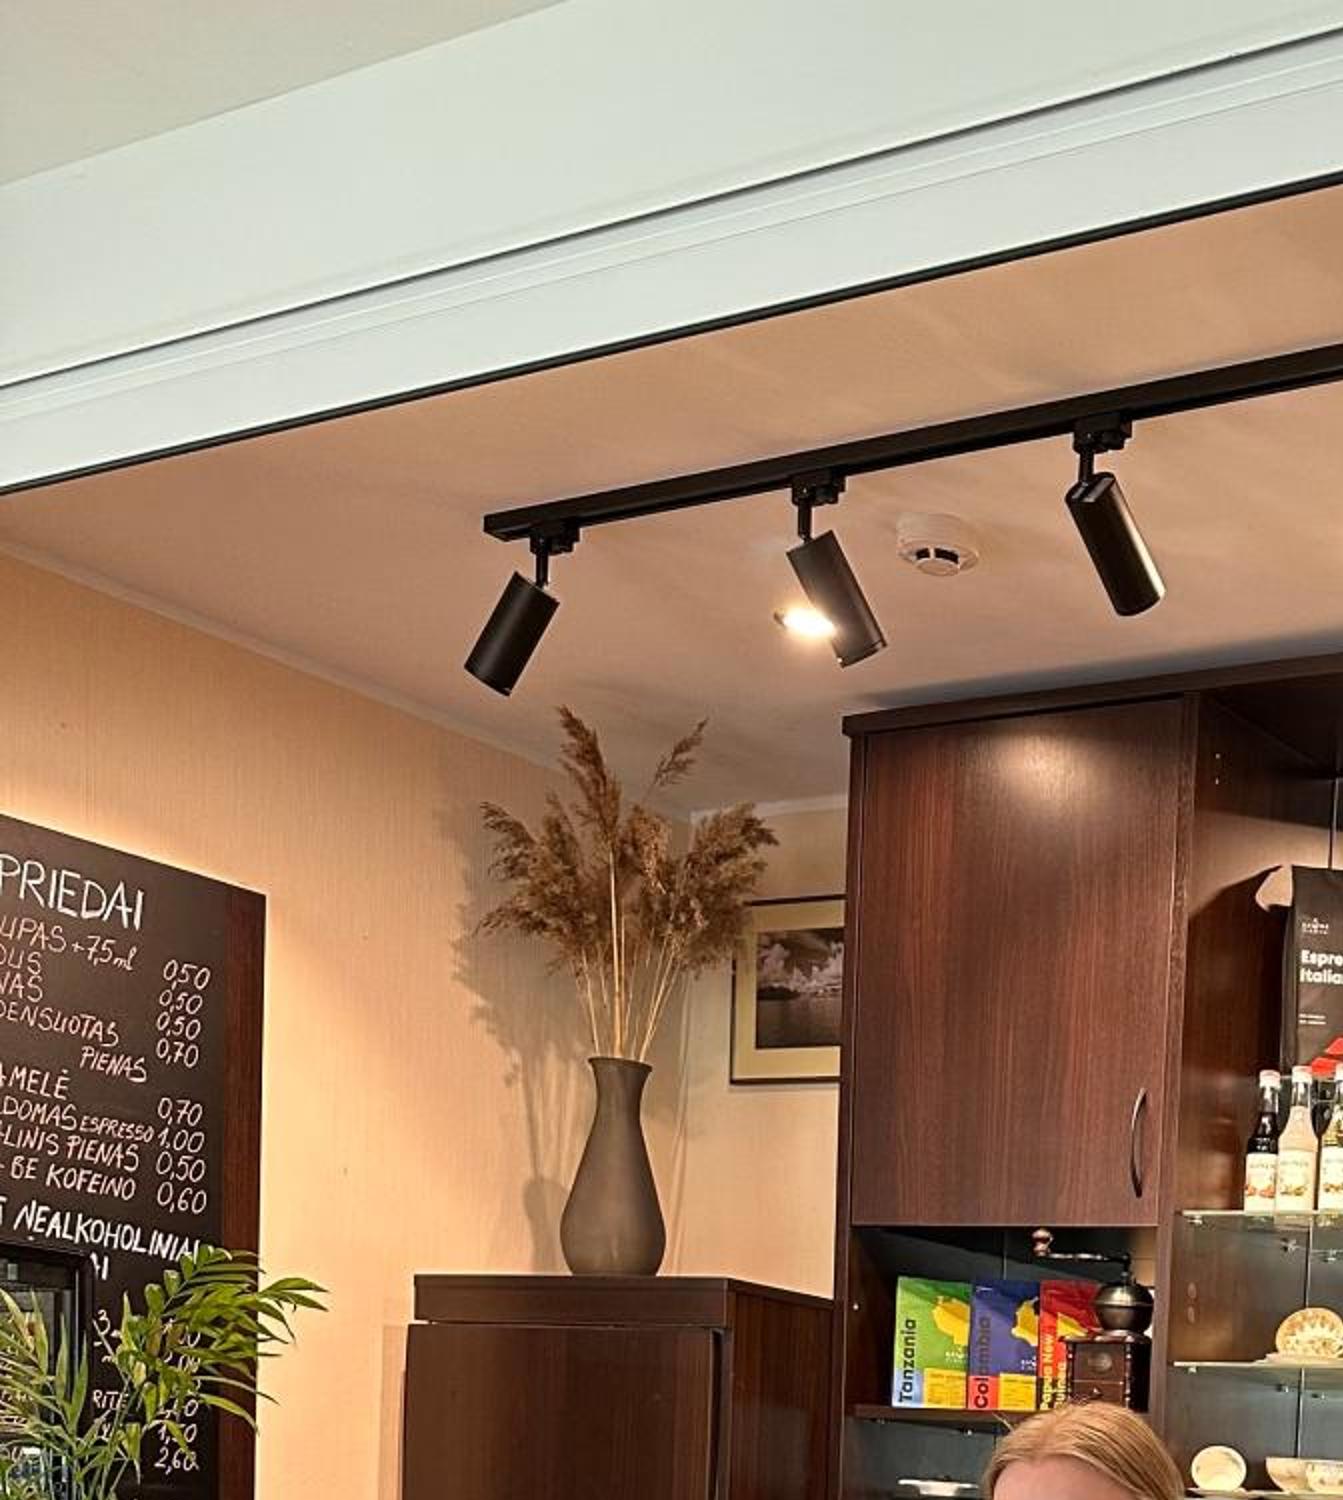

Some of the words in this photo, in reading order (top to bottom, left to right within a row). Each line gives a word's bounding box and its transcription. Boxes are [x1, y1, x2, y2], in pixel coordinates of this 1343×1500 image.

[0, 853, 145, 932] PRIEDAI
[163, 959, 211, 991] 0,50
[159, 988, 203, 1016] 0,50
[156, 1010, 201, 1042] 0,50
[79, 1045, 148, 1084] PIENAS
[155, 1038, 200, 1069] 0,70
[157, 1097, 203, 1128] 0,70
[79, 1114, 155, 1145] ESPRESSO
[157, 1127, 205, 1154] 1,00
[66, 1134, 141, 1173] PIENAS
[156, 1151, 206, 1184] 0,50
[10, 1155, 39, 1180] BE
[45, 1163, 137, 1202] KOFEINO
[156, 1180, 208, 1216] 0,60
[898, 1318, 916, 1403] Tanzania
